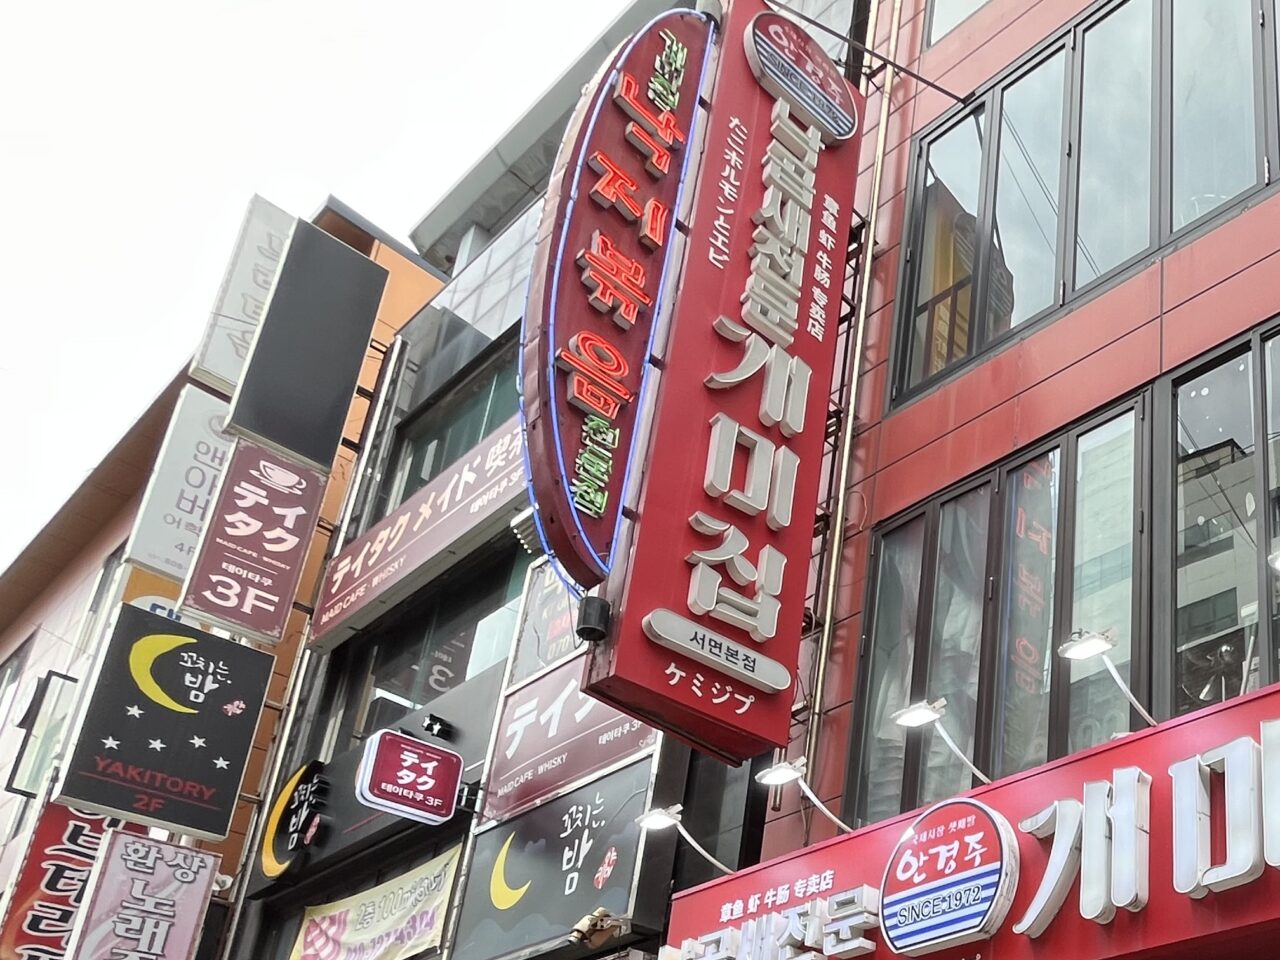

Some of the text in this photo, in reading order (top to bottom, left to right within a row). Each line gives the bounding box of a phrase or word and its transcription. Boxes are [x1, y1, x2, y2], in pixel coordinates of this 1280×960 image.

[685, 313, 813, 643] 개미집
[201, 574, 280, 614] 3F
[689, 630, 758, 674] 서면본점
[183, 673, 221, 704] 밤
[664, 661, 756, 715] ケミジプ
[597, 722, 631, 745] 테이타쿠
[94, 753, 217, 800] YAKITORY
[537, 752, 569, 778] WHISKY
[132, 793, 165, 812] 2F
[380, 782, 443, 809] 테이타쿠 3F
[560, 792, 606, 839] 꼬치는
[121, 839, 207, 884] 환상
[562, 828, 593, 896] 밤
[895, 830, 989, 884] 안경주
[719, 869, 836, 924] 章鱼 虾 牛肠 专卖店
[897, 882, 983, 925] SINCE 1972
